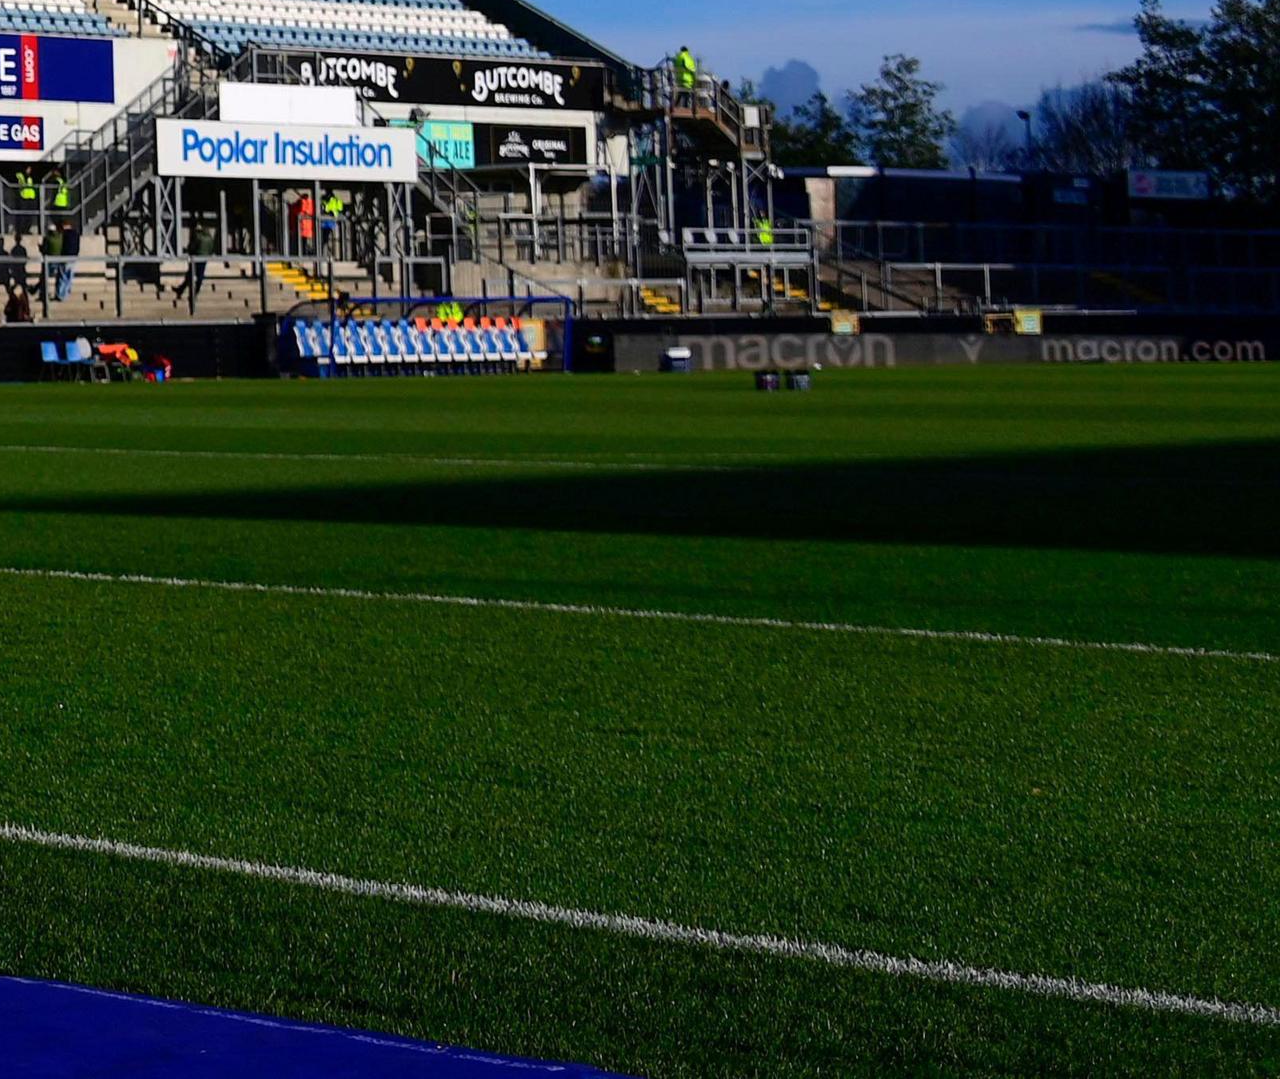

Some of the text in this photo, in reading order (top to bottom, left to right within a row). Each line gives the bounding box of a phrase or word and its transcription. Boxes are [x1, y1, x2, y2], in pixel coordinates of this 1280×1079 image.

[471, 66, 565, 106] BUTCOMBE
[494, 92, 530, 104] BREWING
[11, 124, 40, 142] GAS
[182, 128, 392, 170] Poplar Insulation
[453, 140, 470, 160] ALE
[678, 333, 897, 369] macron
[1042, 337, 1266, 362] macron.com
